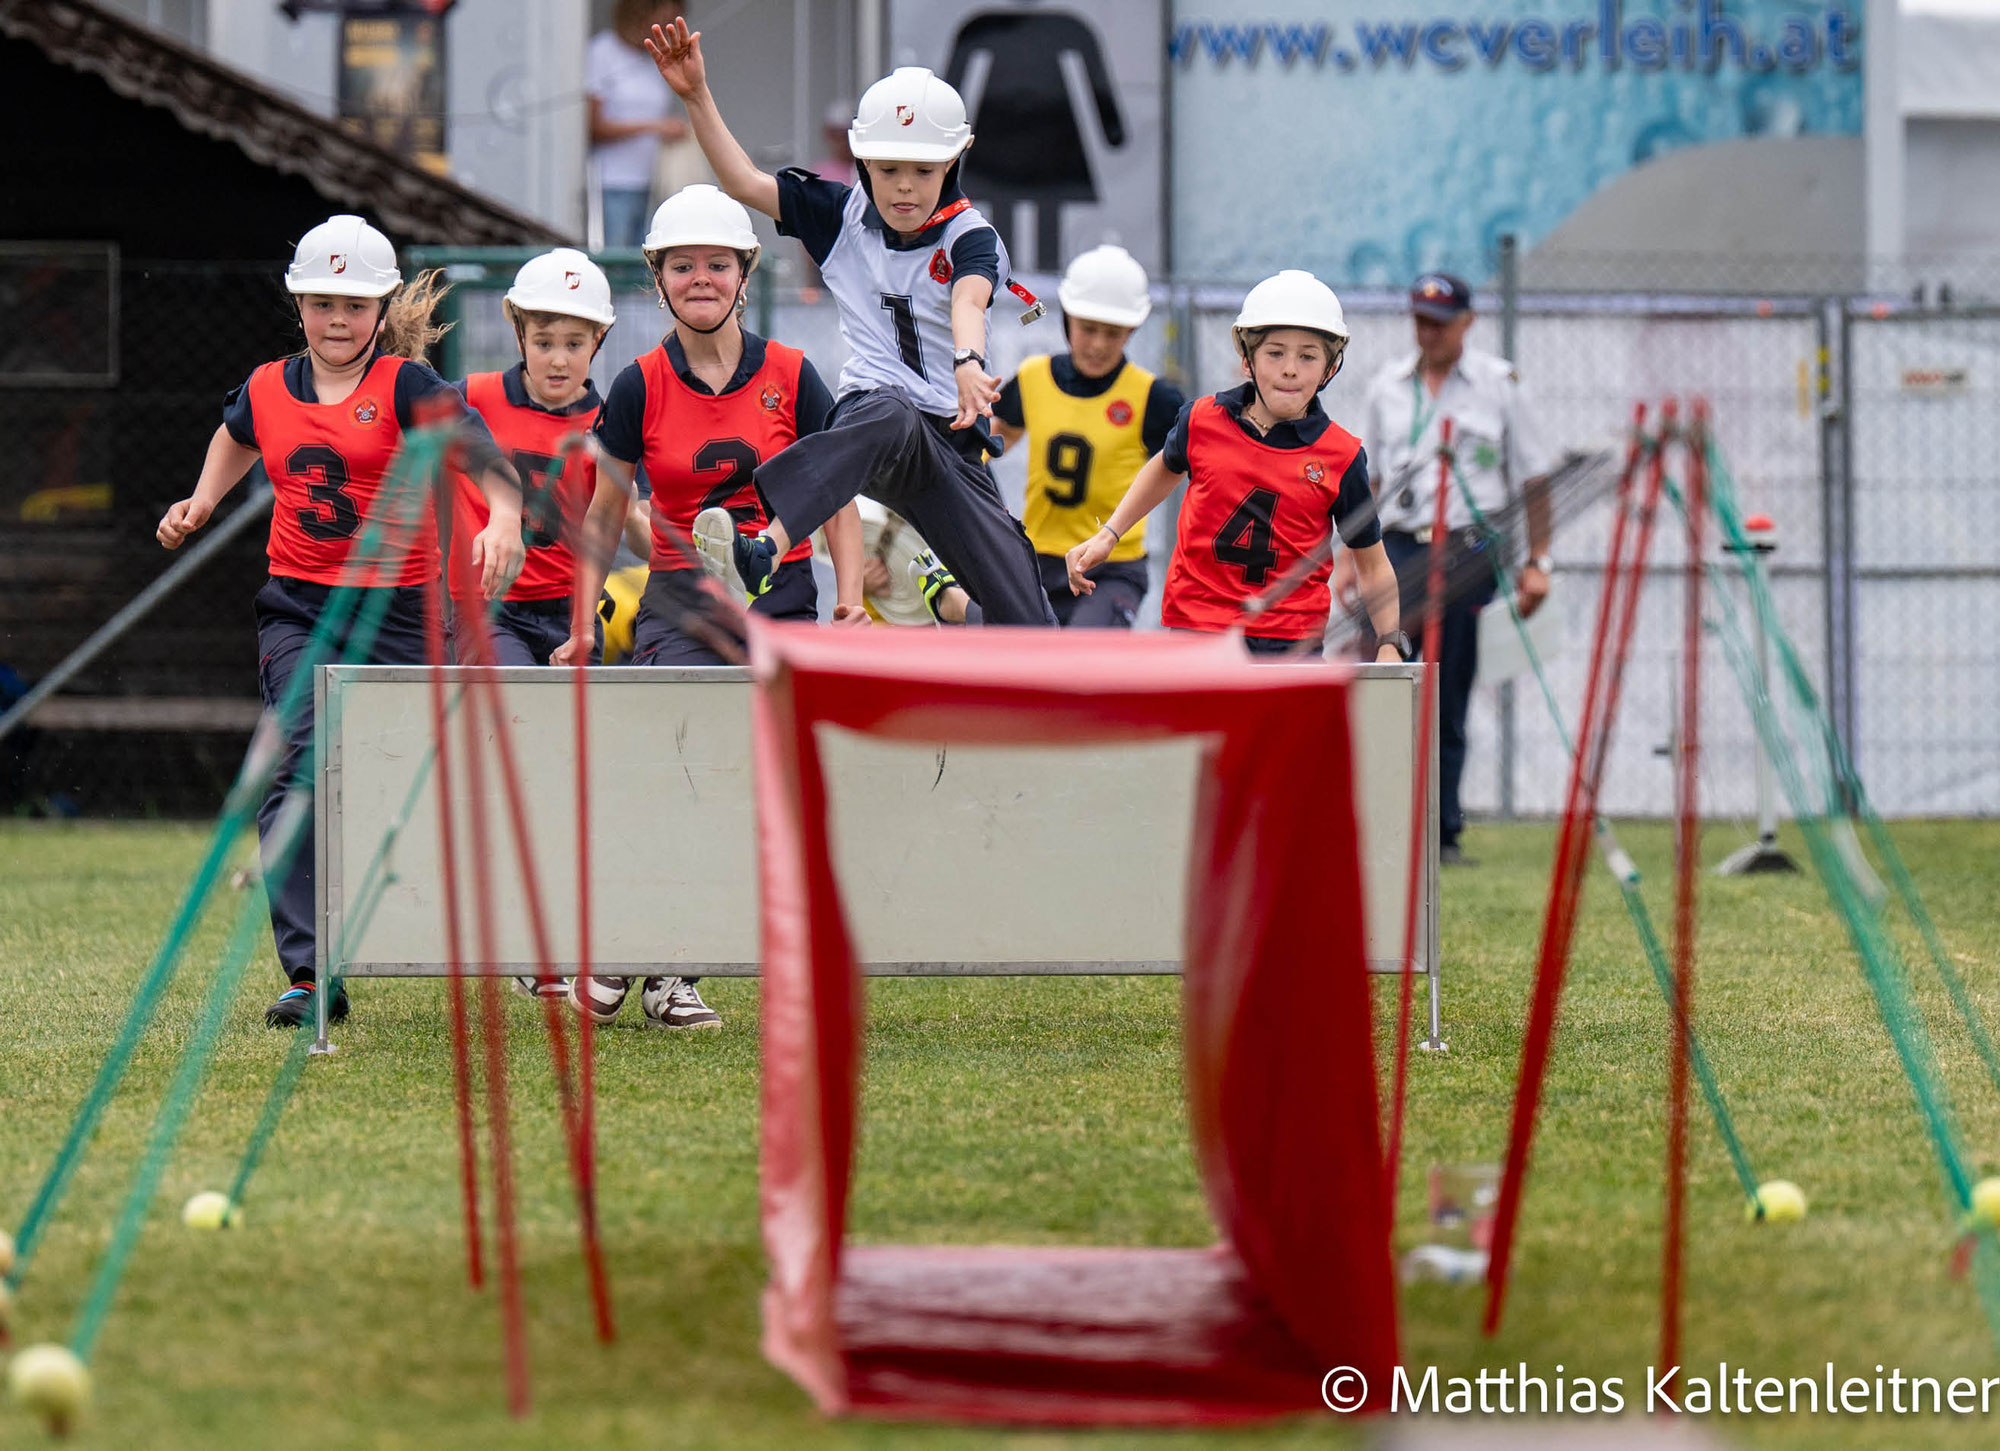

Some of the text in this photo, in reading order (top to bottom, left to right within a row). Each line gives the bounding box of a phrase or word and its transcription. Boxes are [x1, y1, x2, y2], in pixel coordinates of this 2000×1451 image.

[880, 292, 930, 384] 1
[285, 443, 362, 541] 3
[512, 448, 566, 549] 5
[692, 436, 762, 525] 2
[1044, 431, 1095, 509] 9
[1211, 486, 1281, 587] 4
